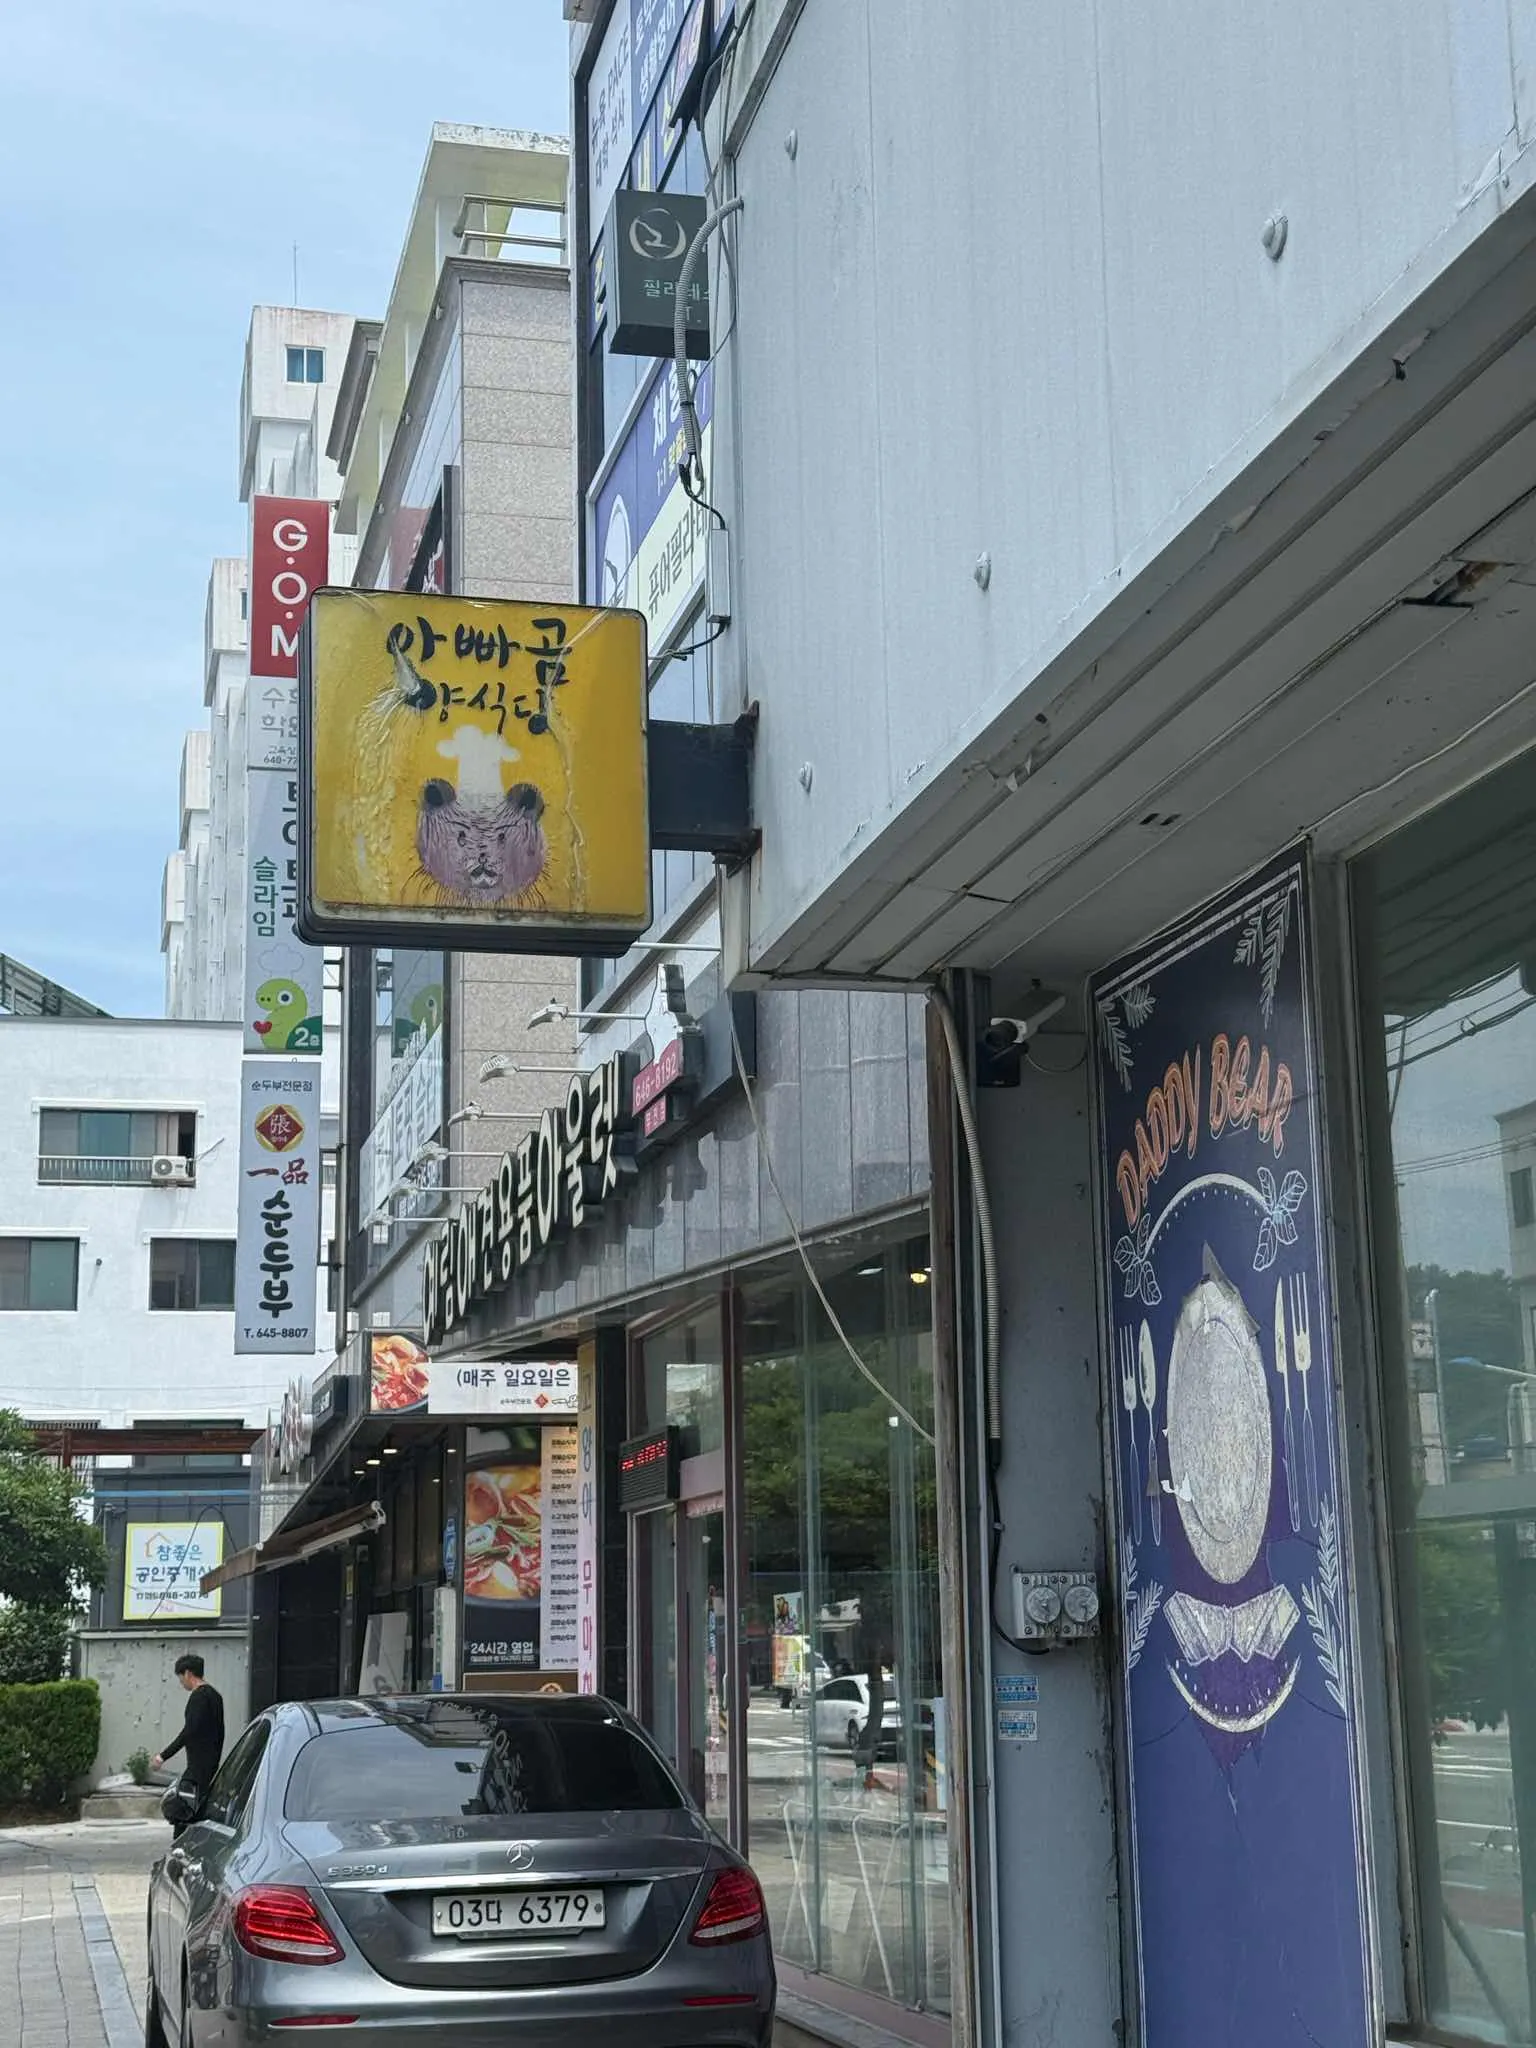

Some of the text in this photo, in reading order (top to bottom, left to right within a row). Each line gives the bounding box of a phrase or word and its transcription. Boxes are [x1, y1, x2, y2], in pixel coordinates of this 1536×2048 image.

[386, 615, 573, 686] 아빠곰
[252, 855, 278, 937] 슬라임
[250, 1080, 313, 1093] 순두부전문점
[1115, 1032, 1294, 1233] DADDY BEAR
[245, 1158, 309, 1185] 一品
[258, 1189, 294, 1319] 순두부
[243, 1328, 309, 1339] T. 645-8807
[456, 1368, 571, 1388] (매주 일요일은
[157, 1544, 203, 1561] 참좋은
[470, 1640, 534, 1655] 24시간 영업
[447, 1893, 590, 1928] 03다 6379
